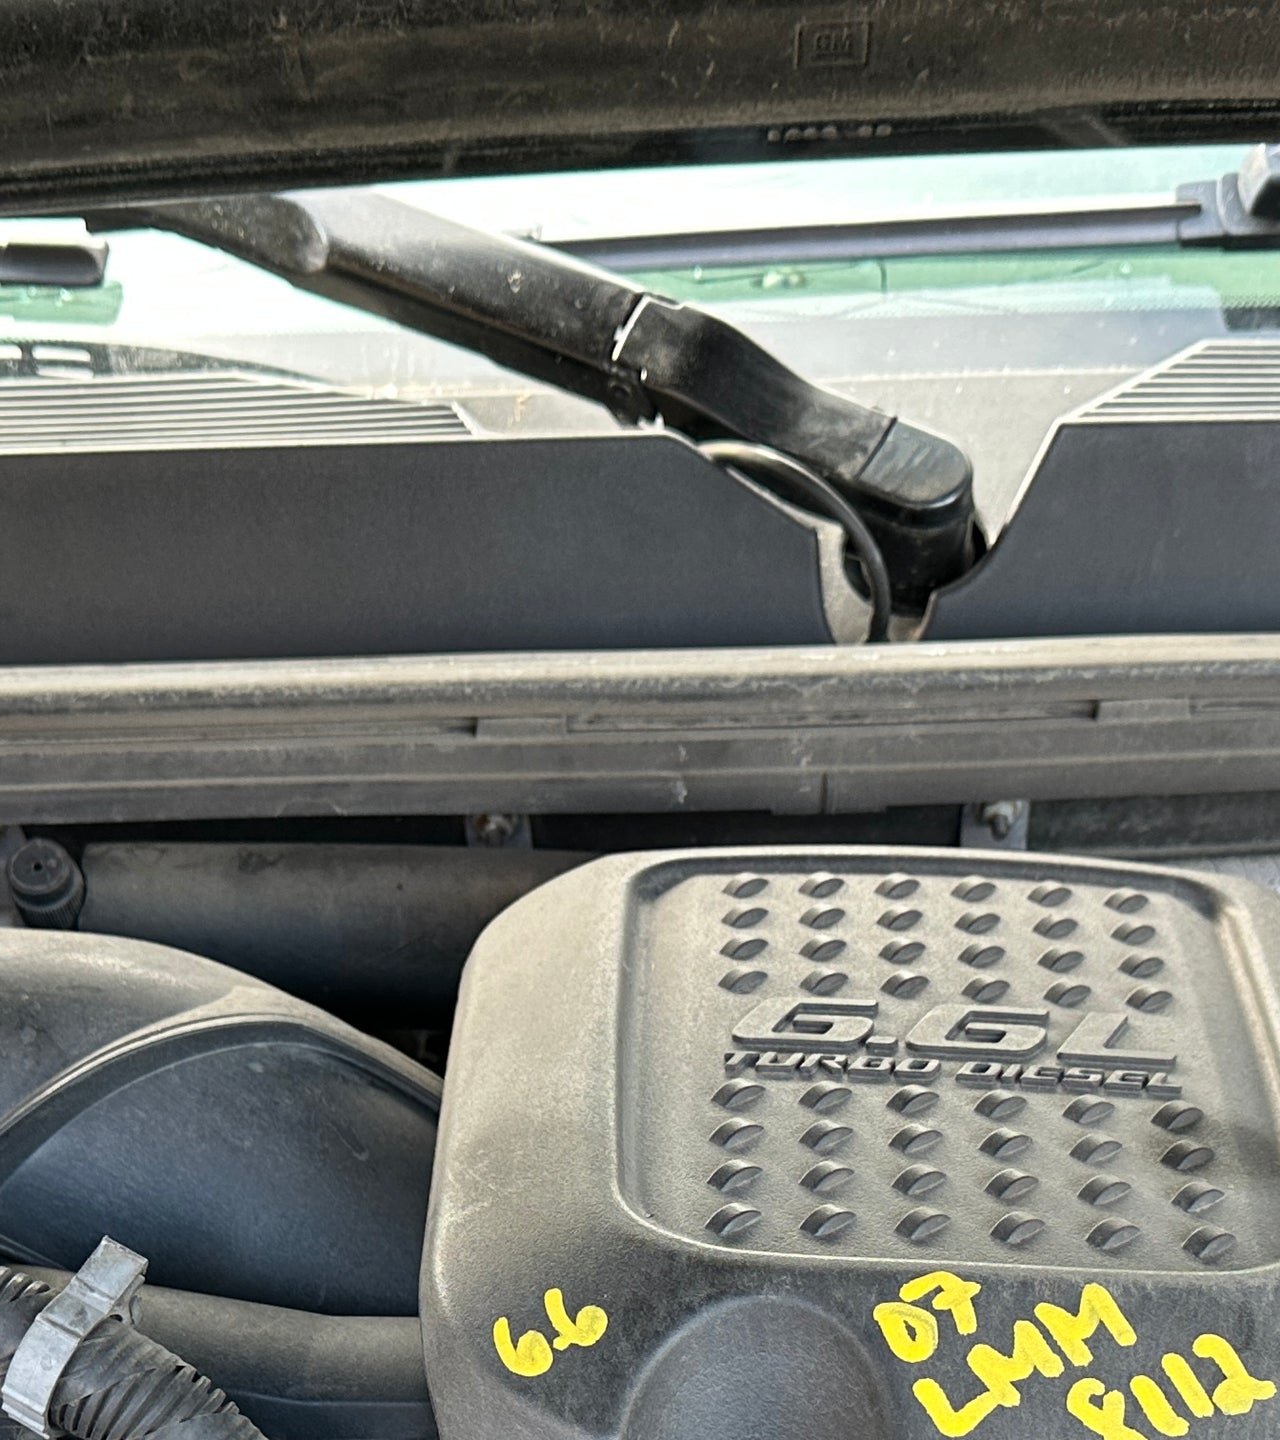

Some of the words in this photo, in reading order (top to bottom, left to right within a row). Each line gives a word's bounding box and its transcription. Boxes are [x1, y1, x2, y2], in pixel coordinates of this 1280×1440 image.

[732, 1000, 1178, 1067] 6.6L
[723, 1052, 942, 1085] TURBO
[955, 1060, 1183, 1097] DIESEL
[913, 1283, 1138, 1438] LMM
